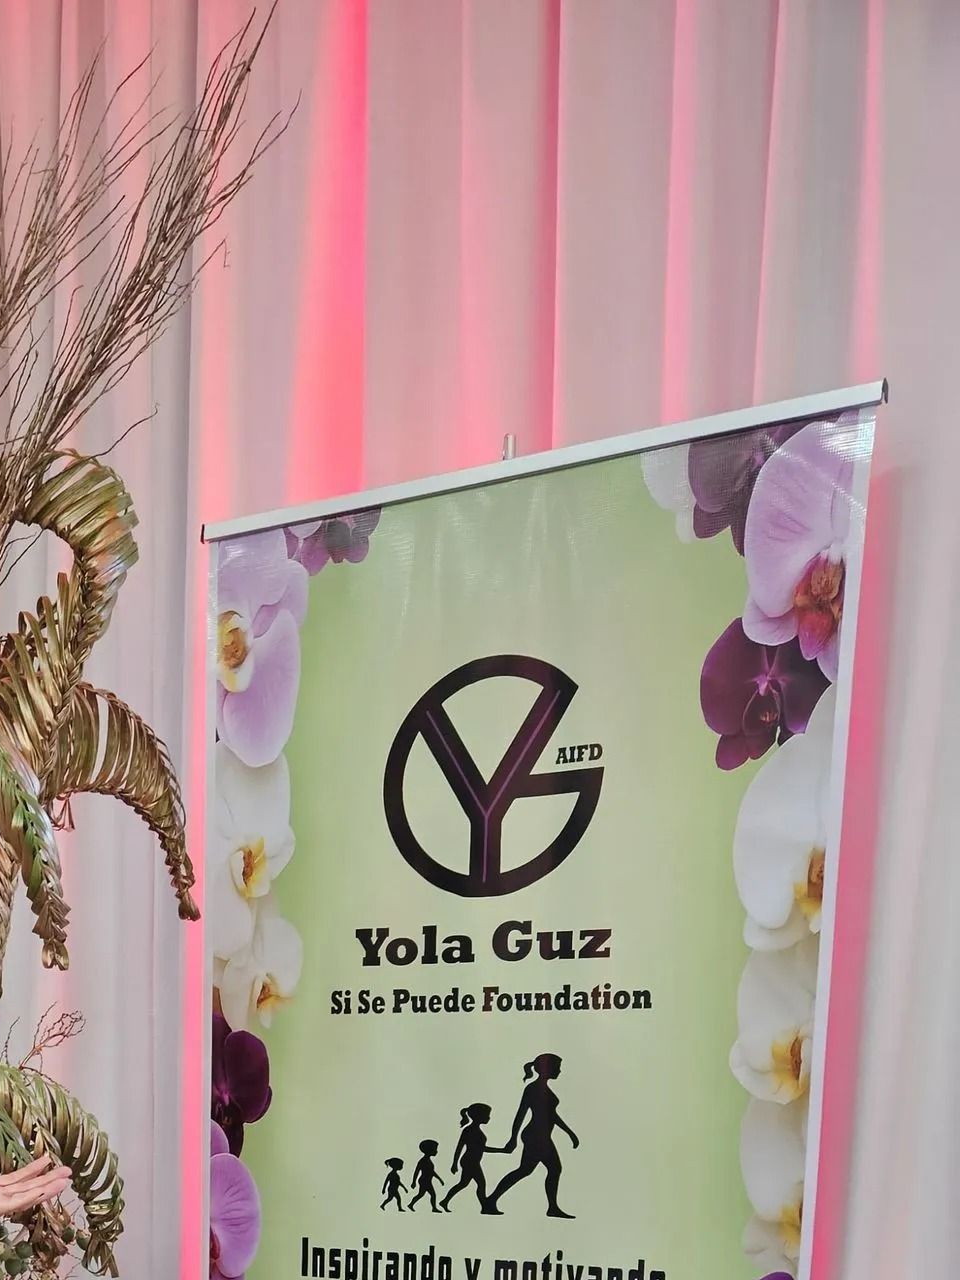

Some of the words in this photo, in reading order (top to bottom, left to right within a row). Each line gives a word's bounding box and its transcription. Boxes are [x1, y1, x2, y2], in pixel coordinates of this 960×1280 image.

[554, 743, 603, 766] AIFD
[355, 926, 475, 967] Yola
[491, 920, 612, 962] Guz
[330, 990, 352, 1015] Si
[357, 989, 386, 1015] Se
[392, 987, 476, 1014] Puede
[481, 982, 652, 1013] Foundation
